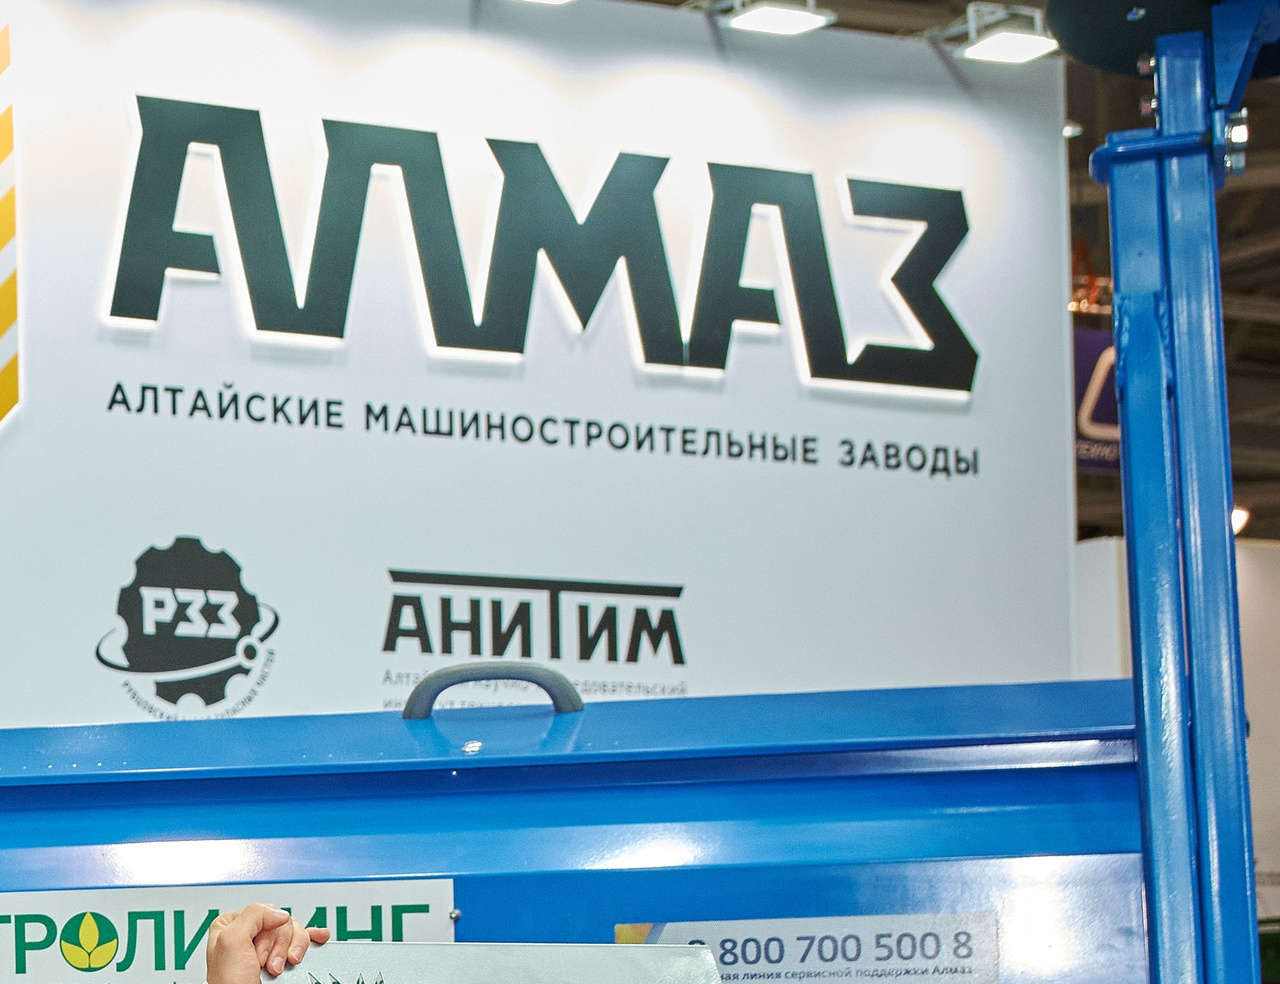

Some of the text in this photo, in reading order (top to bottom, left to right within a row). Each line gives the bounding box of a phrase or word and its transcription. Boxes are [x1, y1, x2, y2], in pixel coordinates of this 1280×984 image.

[109, 94, 980, 393] АЛМАЗ
[107, 382, 980, 478] АЛТАЙСКИЕ МАШИНОСТРОИТЕЛЬНЫЕ ЗАВОДЫ
[381, 569, 686, 665] АНИТИМ
[719, 931, 973, 966] 800 700 500 8
